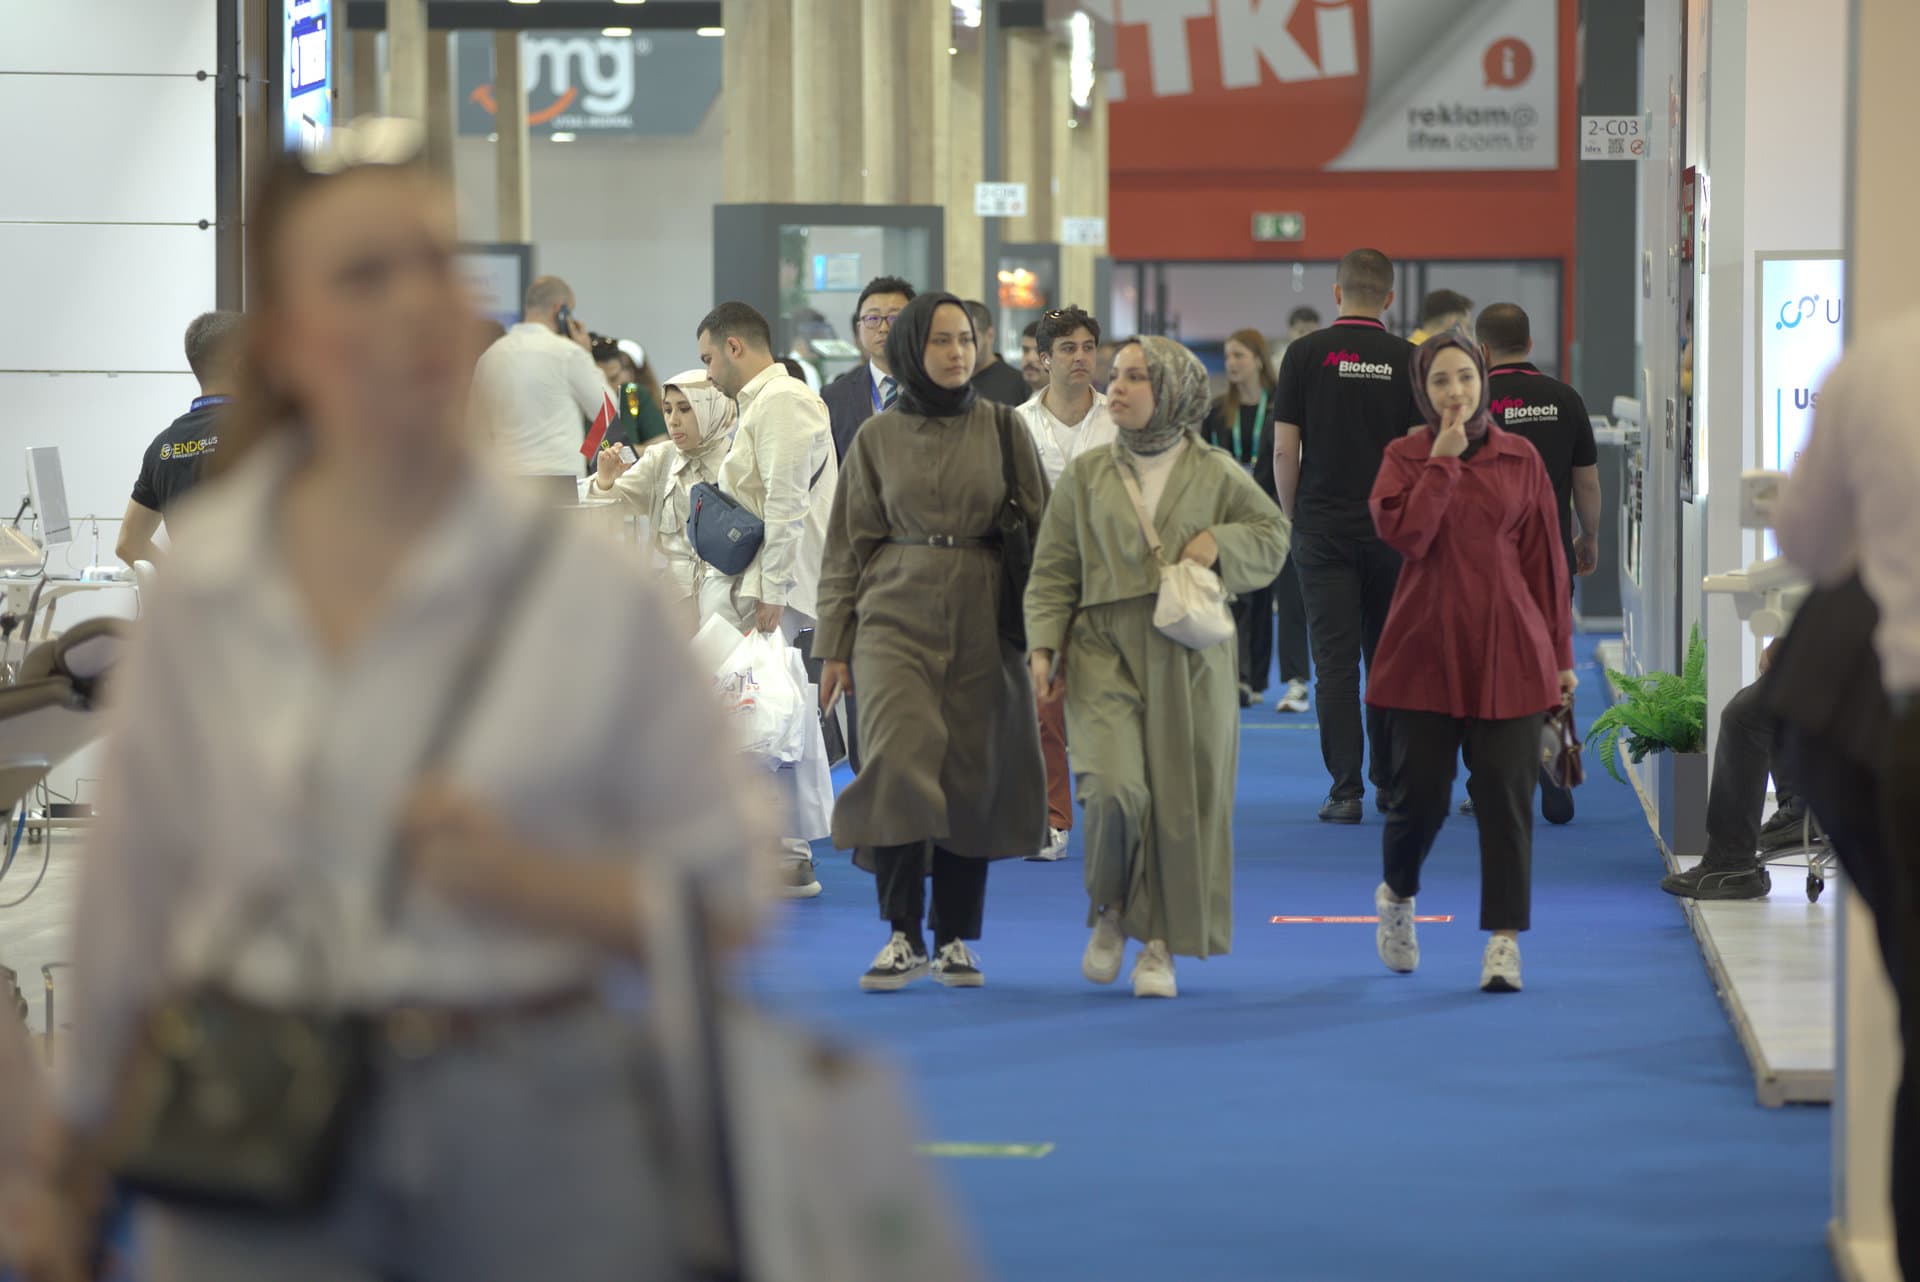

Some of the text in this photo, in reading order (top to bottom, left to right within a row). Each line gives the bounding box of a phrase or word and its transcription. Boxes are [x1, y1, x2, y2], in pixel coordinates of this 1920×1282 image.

[1408, 102, 1539, 128] reklam@
[1588, 120, 1639, 136] 2-C03
[1408, 129, 1537, 151] ifm.com.tr
[1339, 360, 1393, 375] Biotech
[1504, 403, 1559, 420] Biotech
